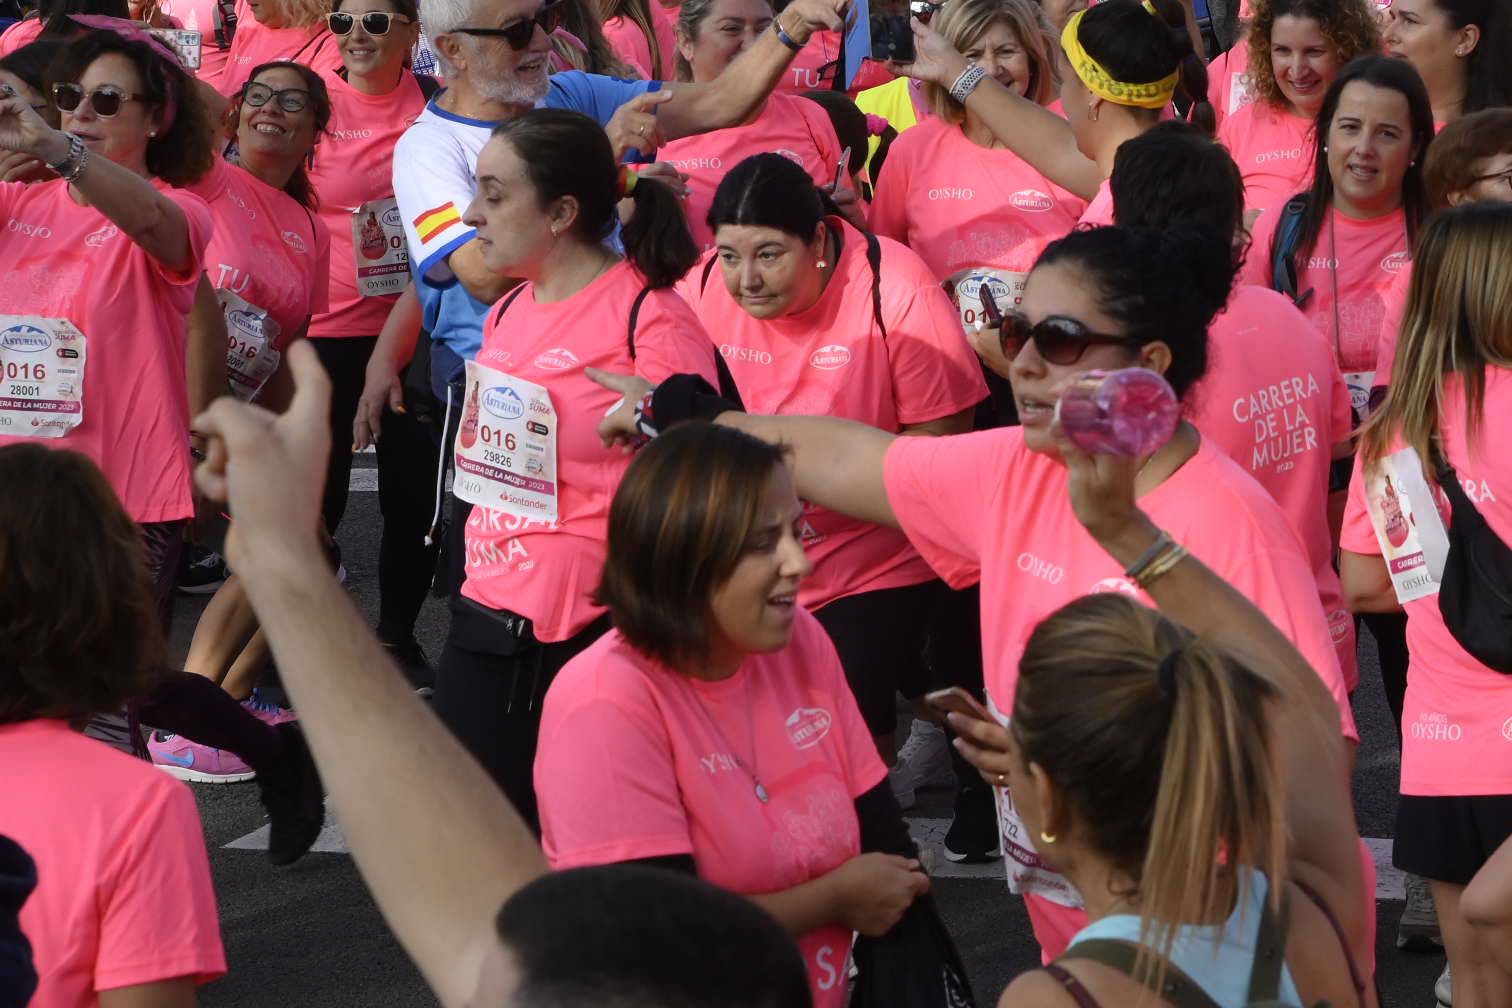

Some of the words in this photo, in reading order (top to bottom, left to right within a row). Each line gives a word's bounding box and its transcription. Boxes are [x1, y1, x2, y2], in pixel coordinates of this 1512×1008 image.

[792, 67, 820, 88] TU
[1255, 148, 1302, 165] OYSHO
[2, 335, 47, 346] ASTURIANA
[720, 343, 772, 367] OYSHO
[7, 363, 46, 381] 016
[10, 385, 40, 396] 28001
[1232, 373, 1321, 424] CARRERA
[485, 394, 521, 415] ASTURIANA
[1255, 413, 1278, 443] DE
[1284, 407, 1311, 432] LA
[480, 424, 517, 451] 016
[484, 449, 513, 468] 29826
[1251, 427, 1318, 470] MUJER
[508, 493, 548, 511] Santander
[1411, 723, 1462, 741] OYSHO
